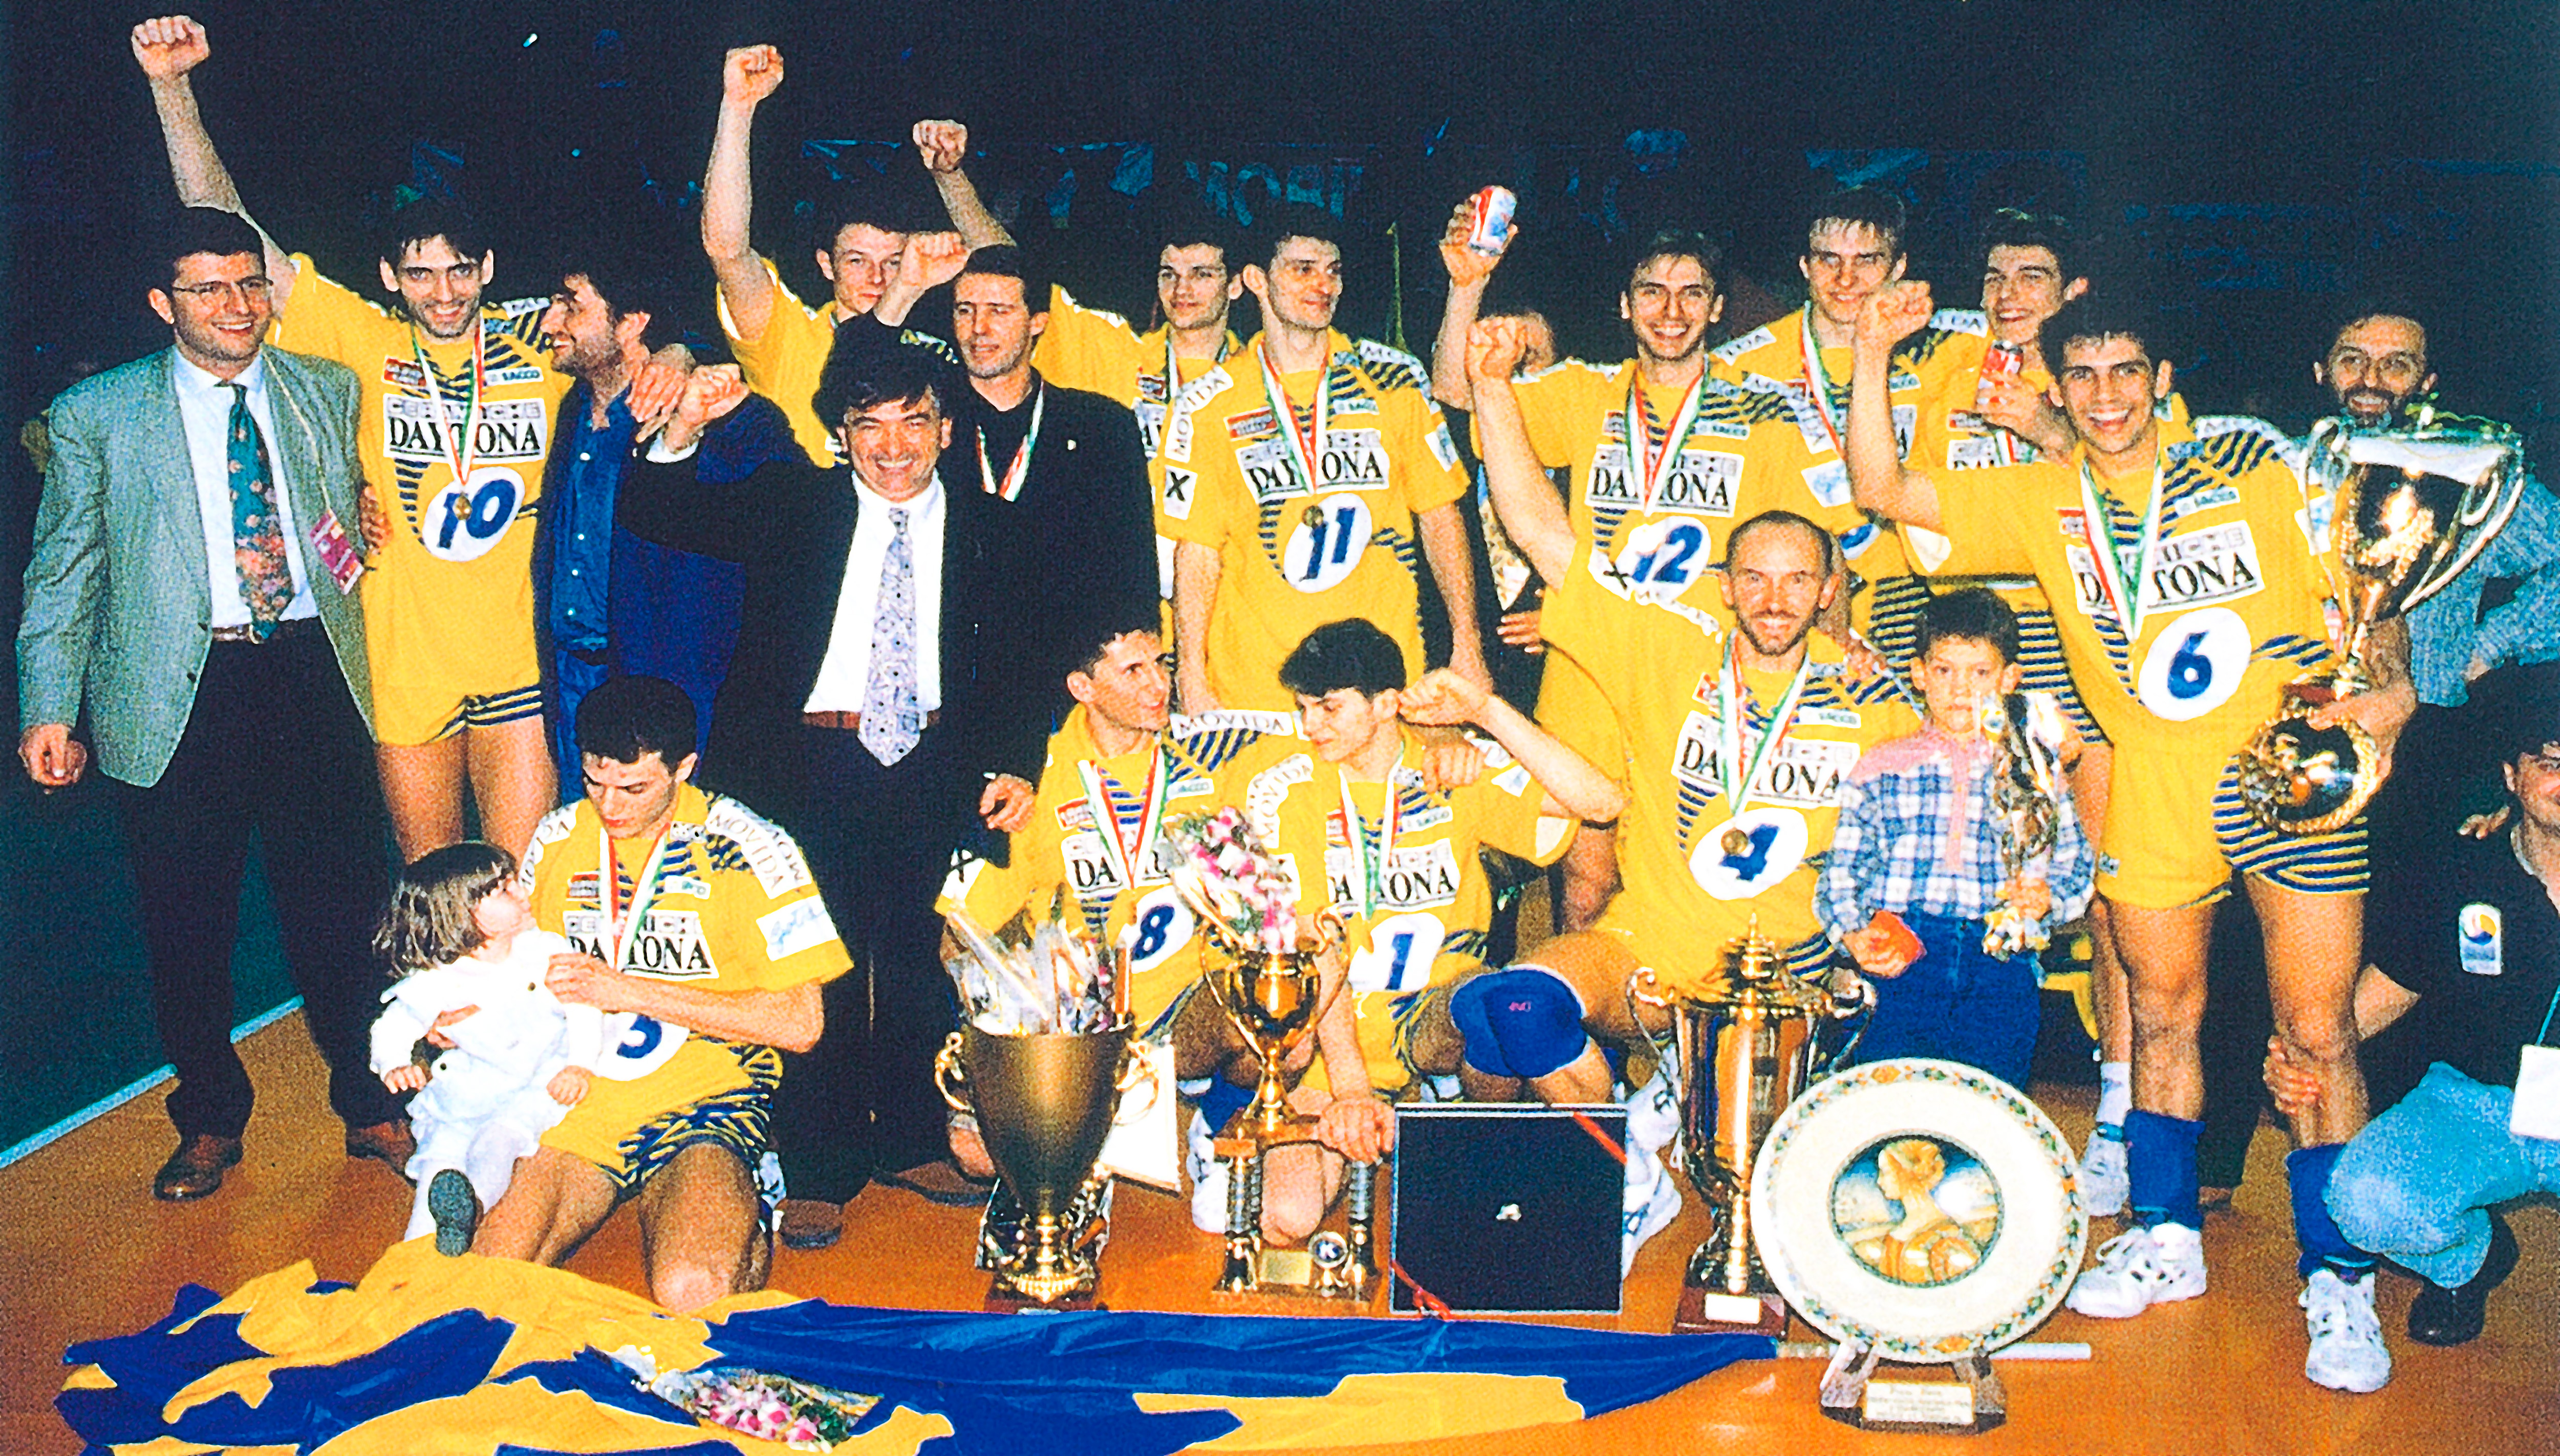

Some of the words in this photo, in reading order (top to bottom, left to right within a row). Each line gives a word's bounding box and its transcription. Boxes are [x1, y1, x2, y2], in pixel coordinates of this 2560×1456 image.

[1245, 450, 1383, 493] DAYONA
[1593, 466, 1730, 507] DAONA
[439, 479, 516, 550] 10
[1301, 508, 1356, 579] 11
[1632, 525, 1703, 584] 12
[2077, 552, 2256, 606] DTONA
[2167, 632, 2212, 700] 6
[1179, 713, 1285, 735] MOVIDA
[1681, 736, 1840, 795] DAONA
[709, 814, 784, 890] MOVIDA
[568, 935, 711, 970] DATONA
[1132, 904, 1175, 961] 8
[1386, 932, 1414, 991] 1
